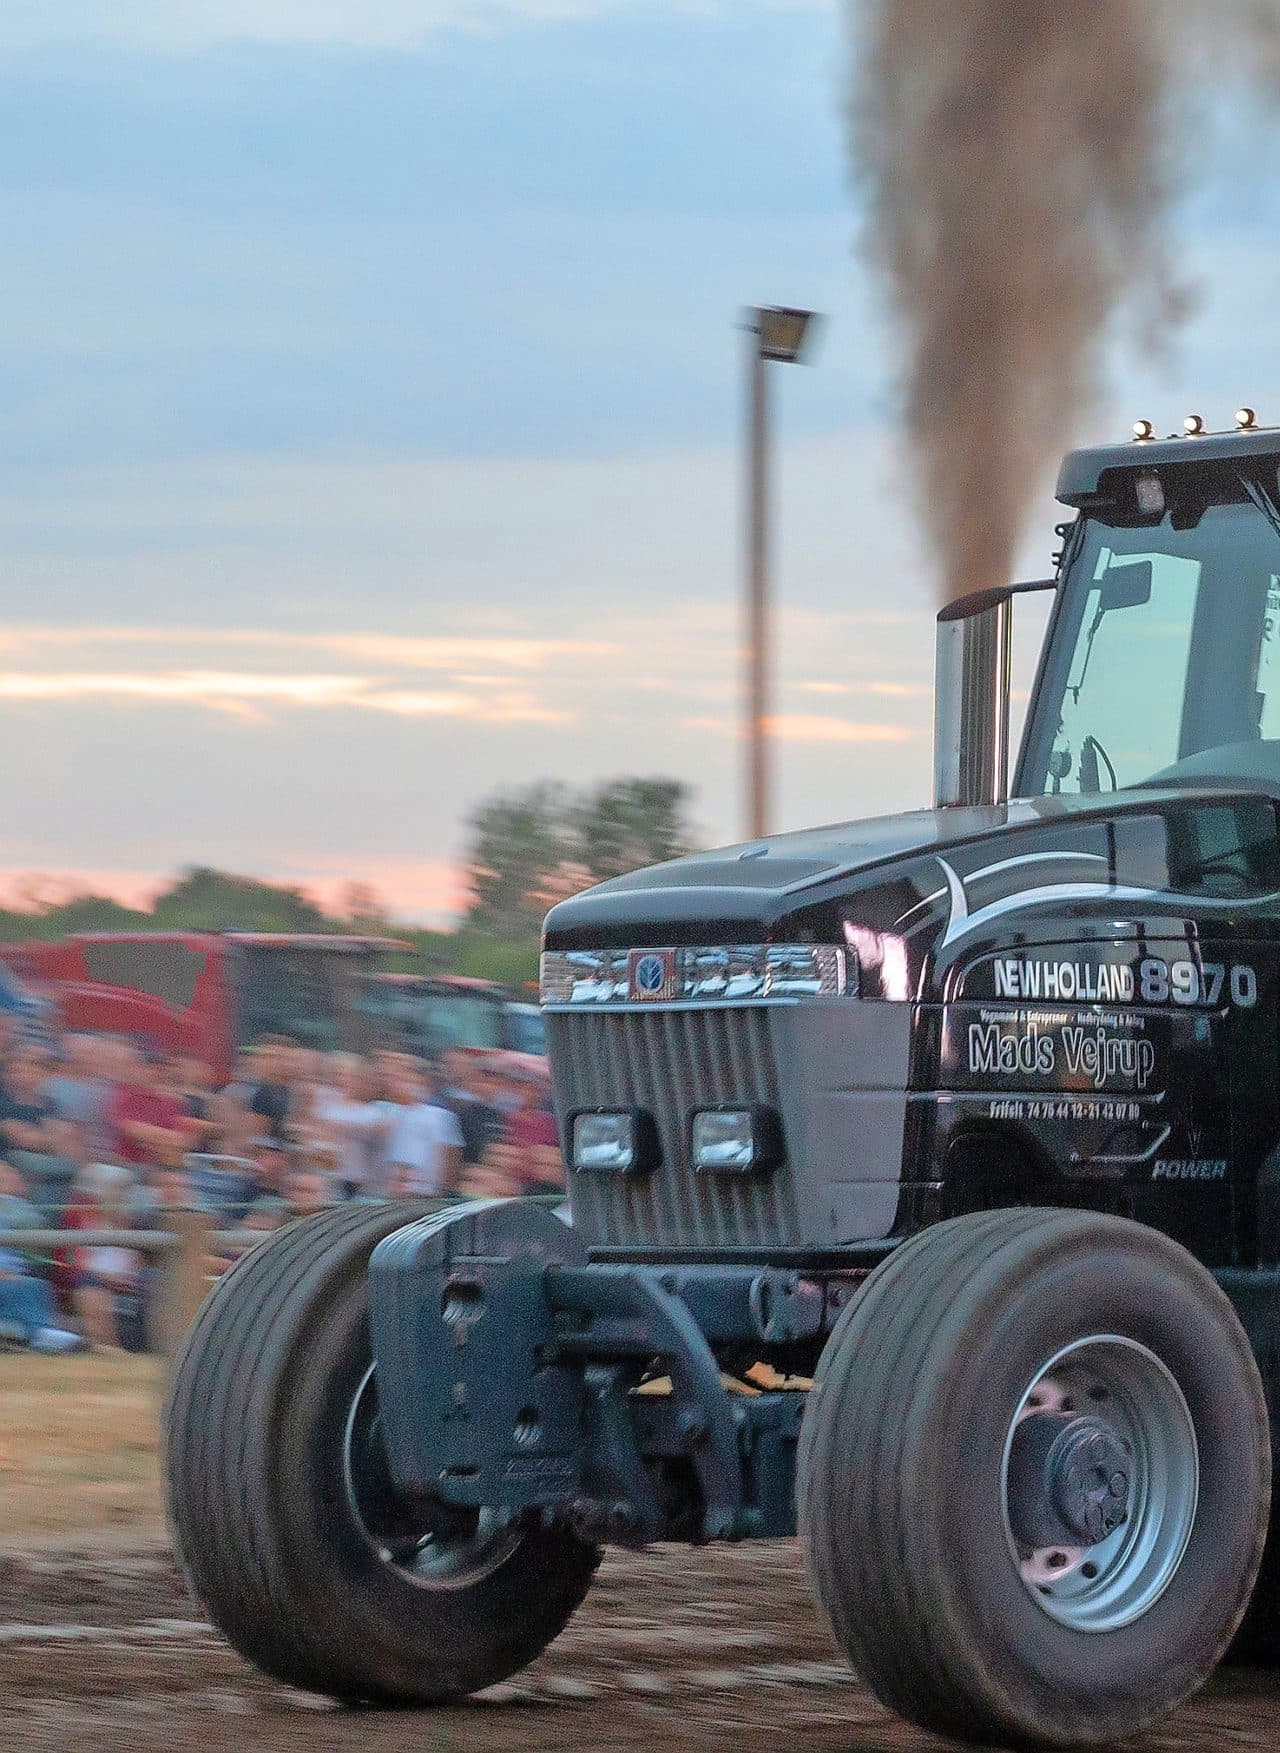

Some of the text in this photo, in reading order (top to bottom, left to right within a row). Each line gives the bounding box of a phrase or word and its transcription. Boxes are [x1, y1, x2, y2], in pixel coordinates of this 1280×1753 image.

[993, 958, 1257, 1008] NEW HOLLAND 8970
[968, 1023, 1155, 1088] Mads Vejrup
[1152, 1160, 1227, 1181] POWER
